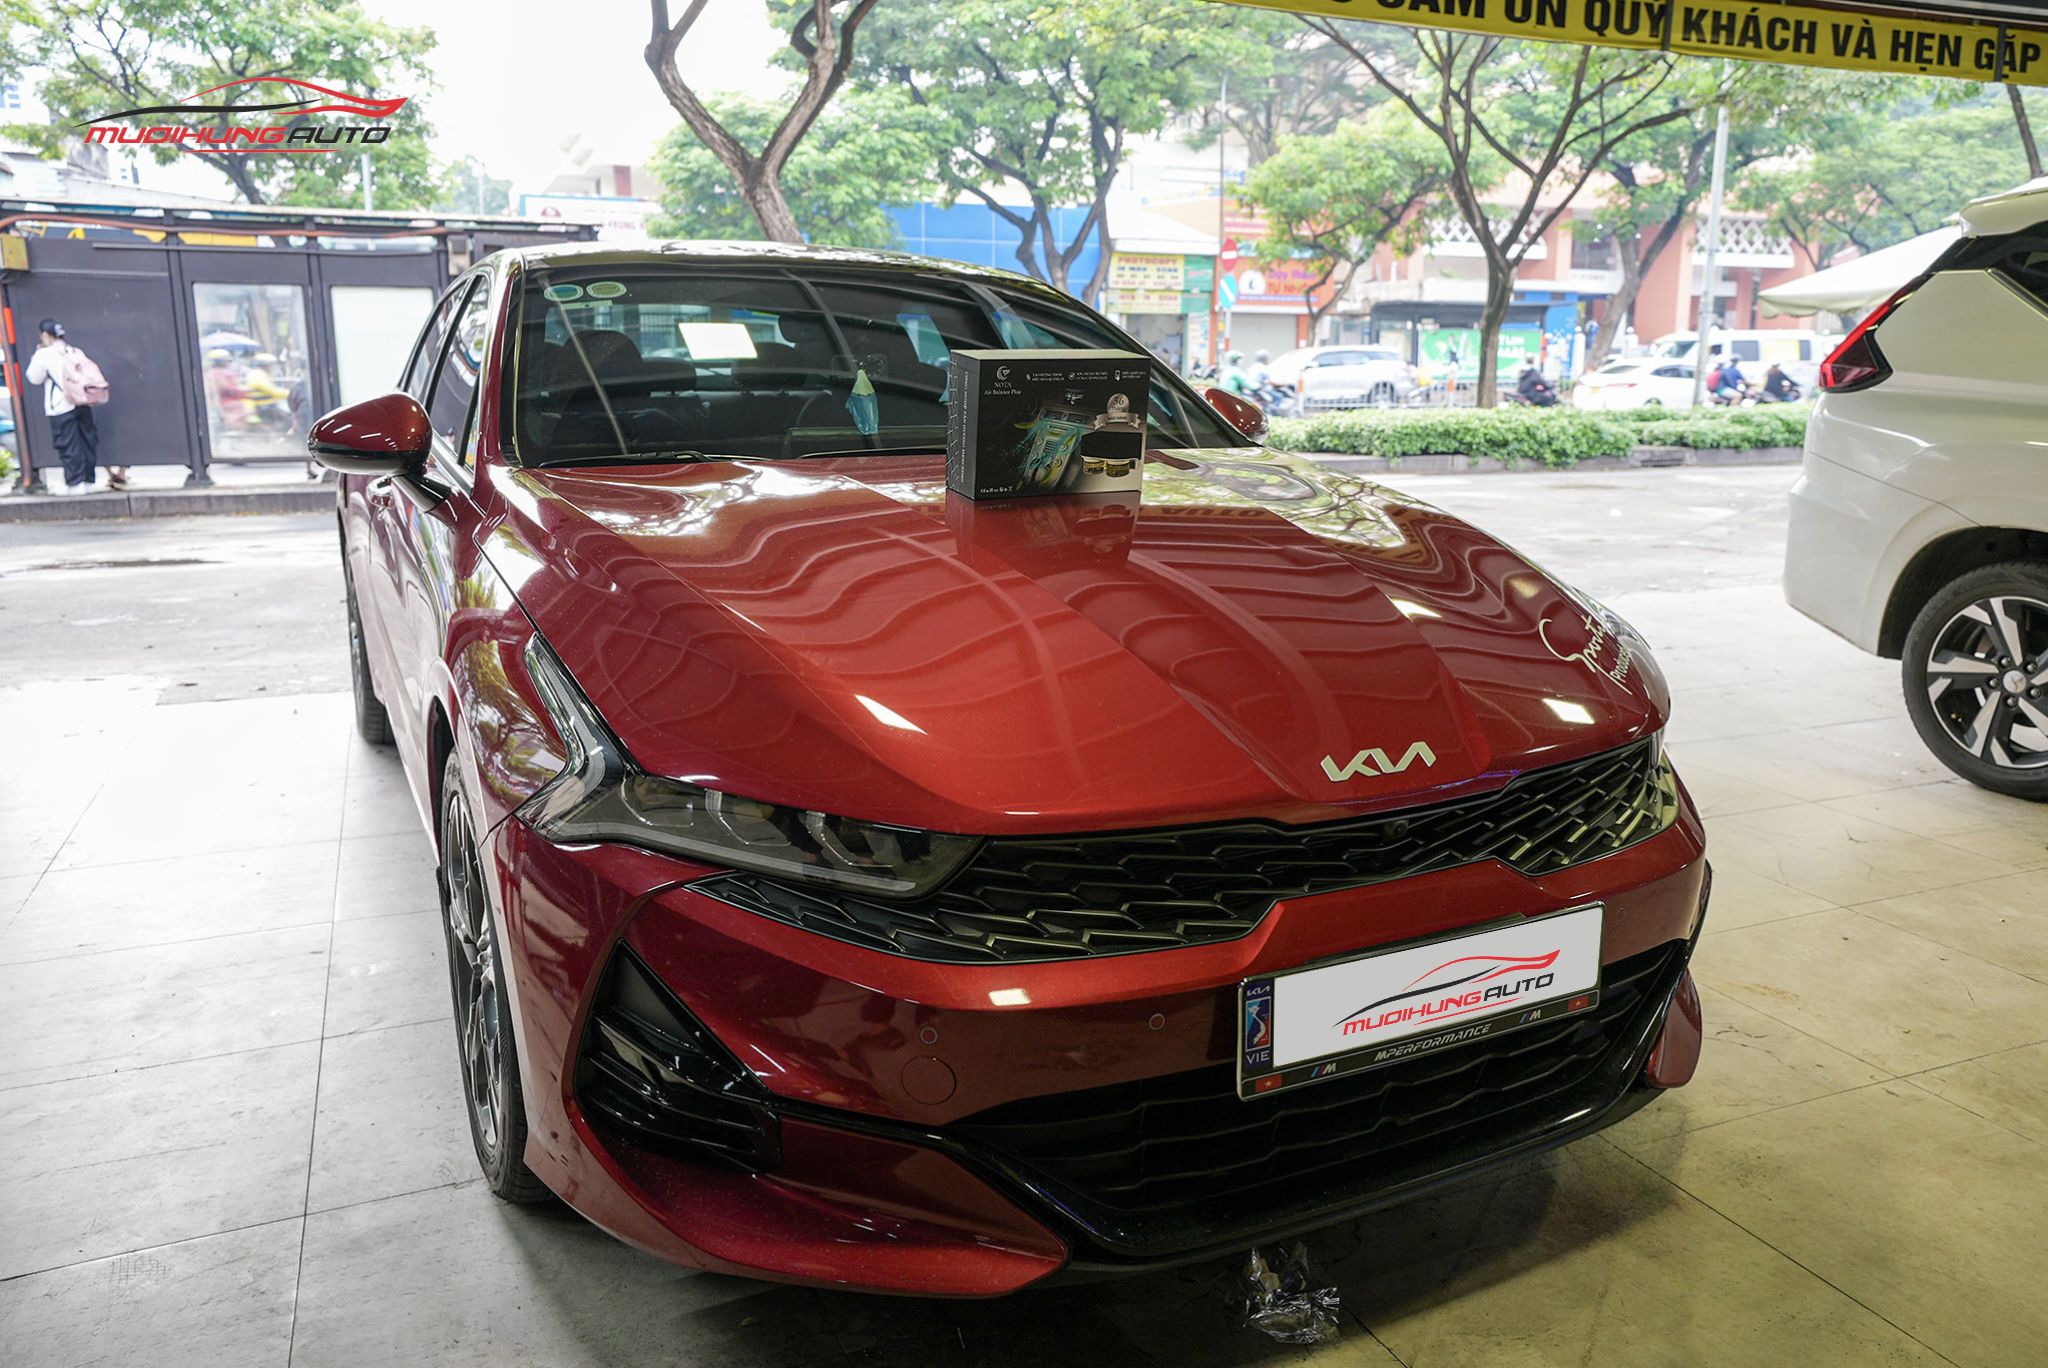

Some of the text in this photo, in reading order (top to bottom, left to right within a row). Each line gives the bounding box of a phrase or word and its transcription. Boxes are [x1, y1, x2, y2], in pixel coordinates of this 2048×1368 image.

[1682, 7, 1818, 54] KHÁCH
[1831, 18, 1877, 60] VÀ
[1889, 29, 1962, 72] HẸN
[1974, 33, 2041, 79] GẶP
[1320, 741, 1437, 782] KIA
[1247, 985, 1271, 997] KIA
[1246, 1050, 1270, 1064] VIE
